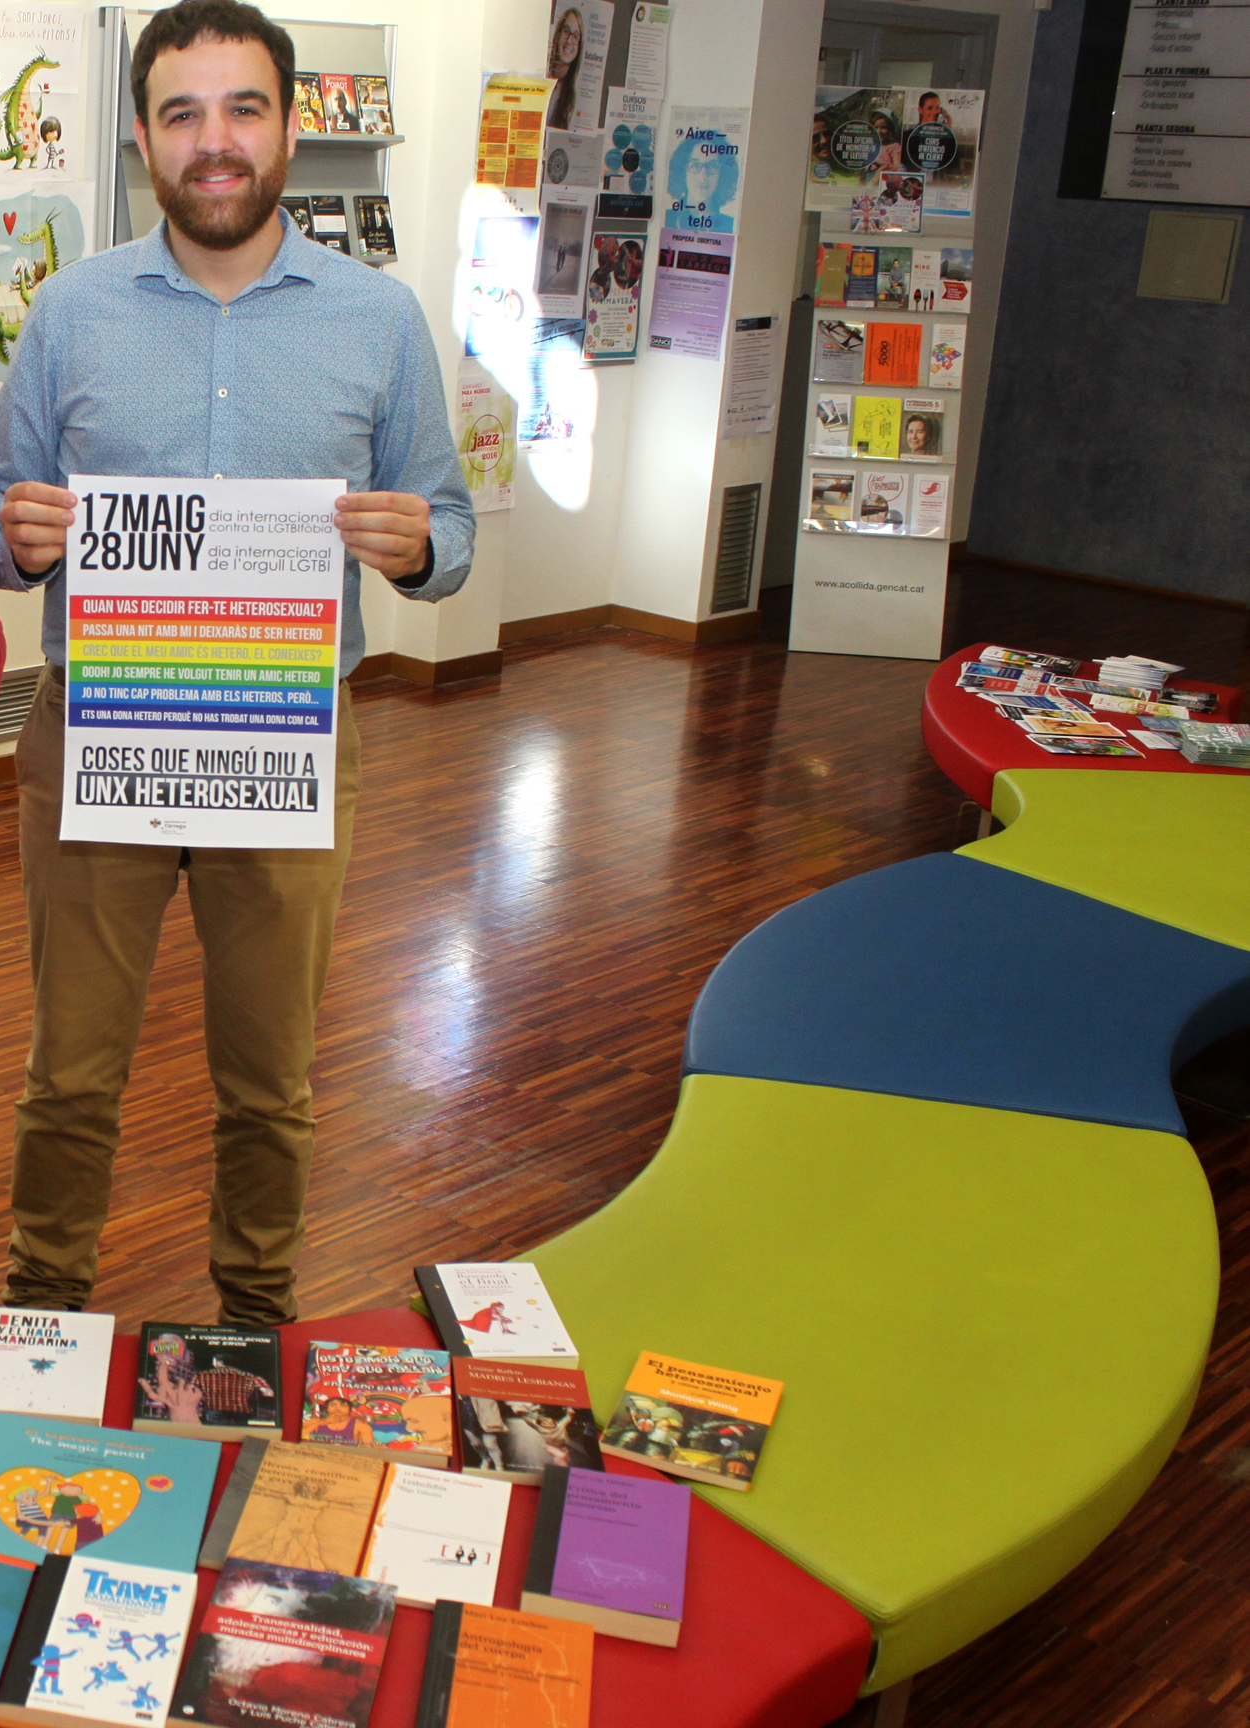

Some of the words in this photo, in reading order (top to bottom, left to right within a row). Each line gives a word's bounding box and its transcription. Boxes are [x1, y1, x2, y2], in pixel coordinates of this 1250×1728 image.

[325, 79, 348, 90] POIROT
[1135, 124, 1163, 132] PLANTA
[1166, 125, 1195, 133] SEGONA
[701, 144, 738, 156] quem
[689, 216, 712, 228] teló
[471, 432, 499, 452] jazz
[482, 452, 498, 460] 2016
[815, 580, 924, 593] www.acollida.gencat.cat
[80, 775, 128, 804] UNX
[135, 776, 315, 810] HETEROSEXUAL
[0, 1315, 59, 1329] BENITA
[0, 1326, 5, 1334] Y
[9, 1327, 21, 1335] EL
[469, 1371, 514, 1383] MADRES
[517, 1377, 576, 1389] LESBIANAS
[647, 1359, 664, 1368] El
[668, 1365, 772, 1393] pensamiento
[655, 1368, 759, 1398] heterosexual
[660, 1388, 705, 1404] Monique
[30, 1436, 52, 1448] The
[58, 1440, 98, 1454] magic
[104, 1446, 146, 1460] pencil
[217, 1617, 298, 1637] adolescencias
[220, 1626, 264, 1639] miradas
[252, 1614, 343, 1638] Transexualidad,
